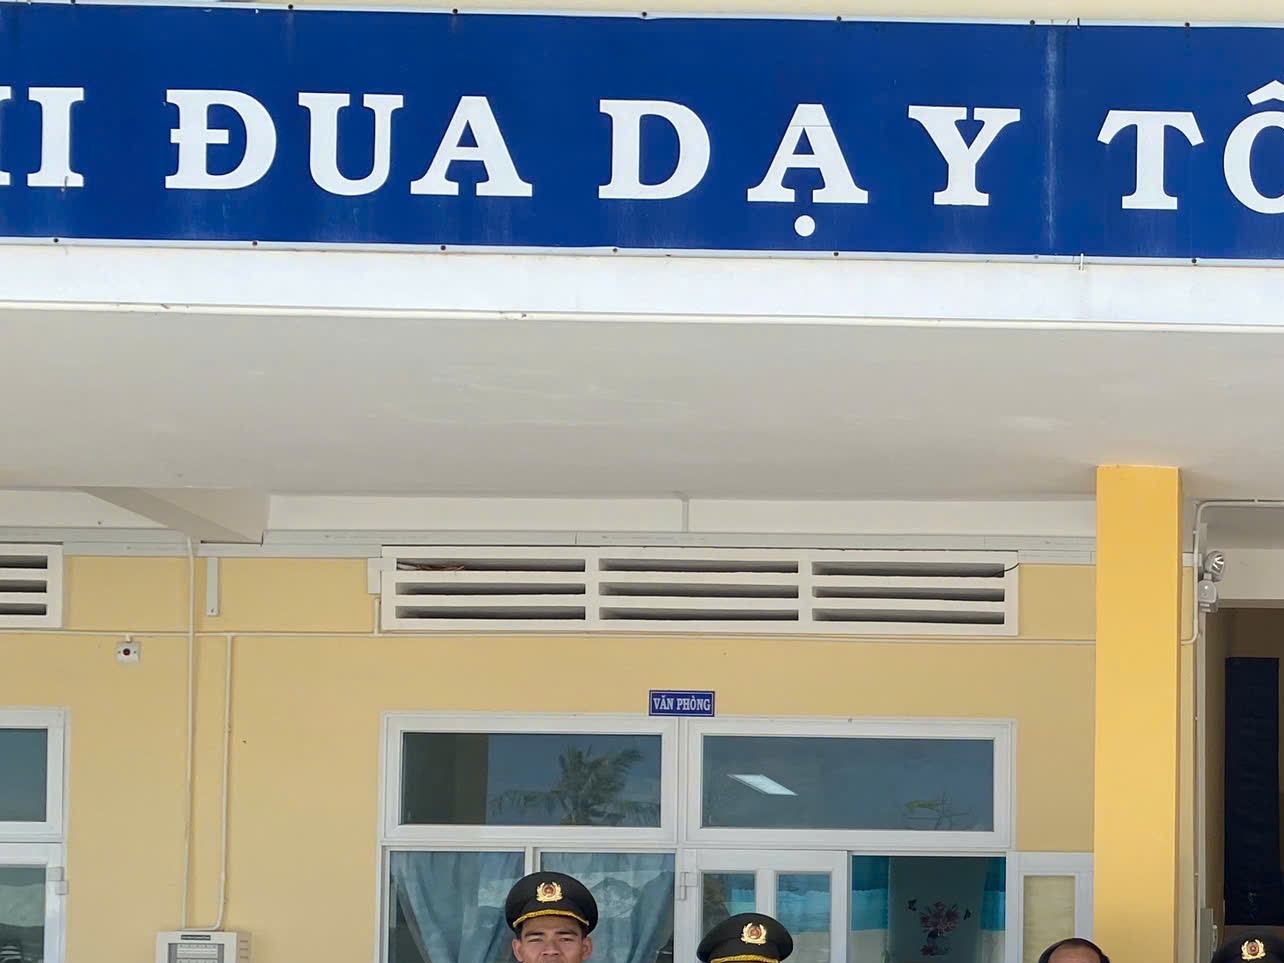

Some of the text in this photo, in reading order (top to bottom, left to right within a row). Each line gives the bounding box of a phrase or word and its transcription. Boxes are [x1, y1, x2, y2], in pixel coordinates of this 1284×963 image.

[0, 86, 84, 187] I
[166, 90, 532, 196] ĐUA
[599, 100, 1020, 236] DẠY
[653, 695, 711, 711] VĂN PHÒNG
